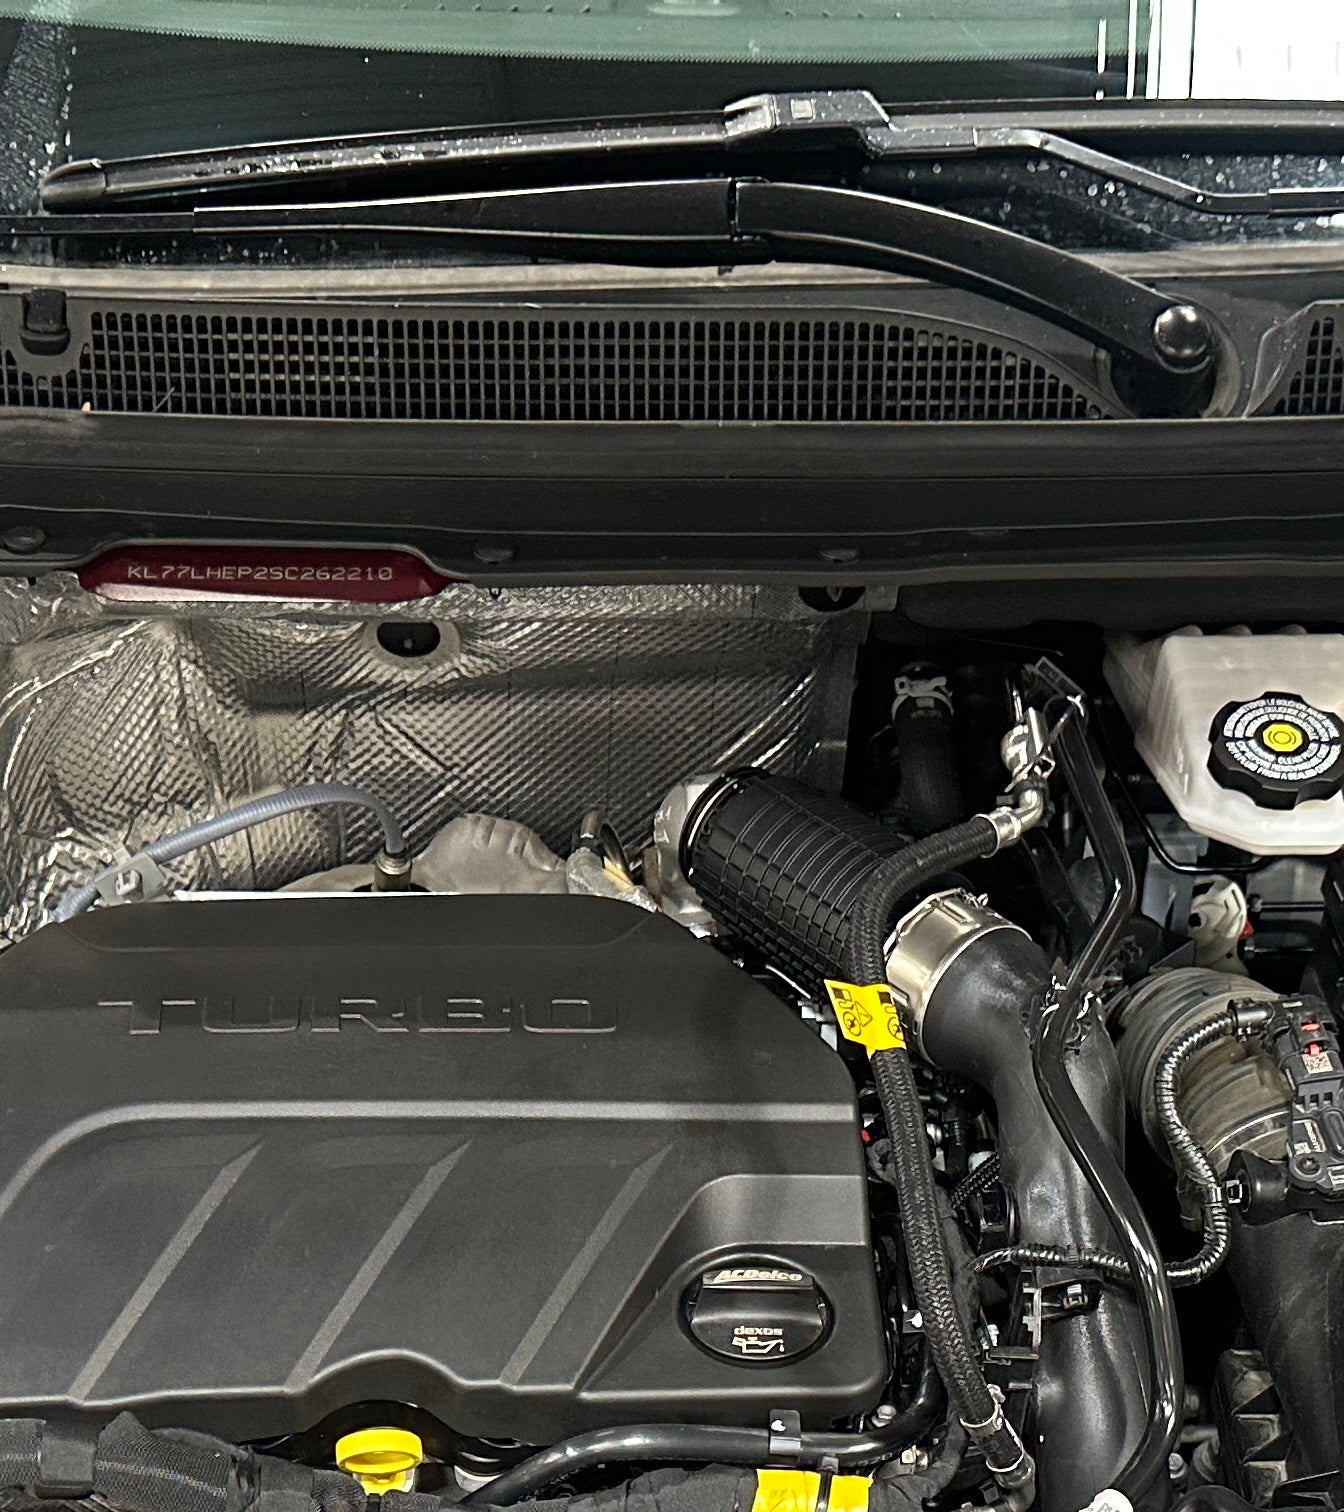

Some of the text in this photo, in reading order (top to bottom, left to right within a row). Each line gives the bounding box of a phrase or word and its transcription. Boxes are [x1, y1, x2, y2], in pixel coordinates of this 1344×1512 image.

[127, 565, 394, 582] KL77LHEP2SC262210
[98, 997, 617, 1035] TURBO
[712, 1269, 803, 1284] ACDelco
[733, 1325, 784, 1336] dexos
